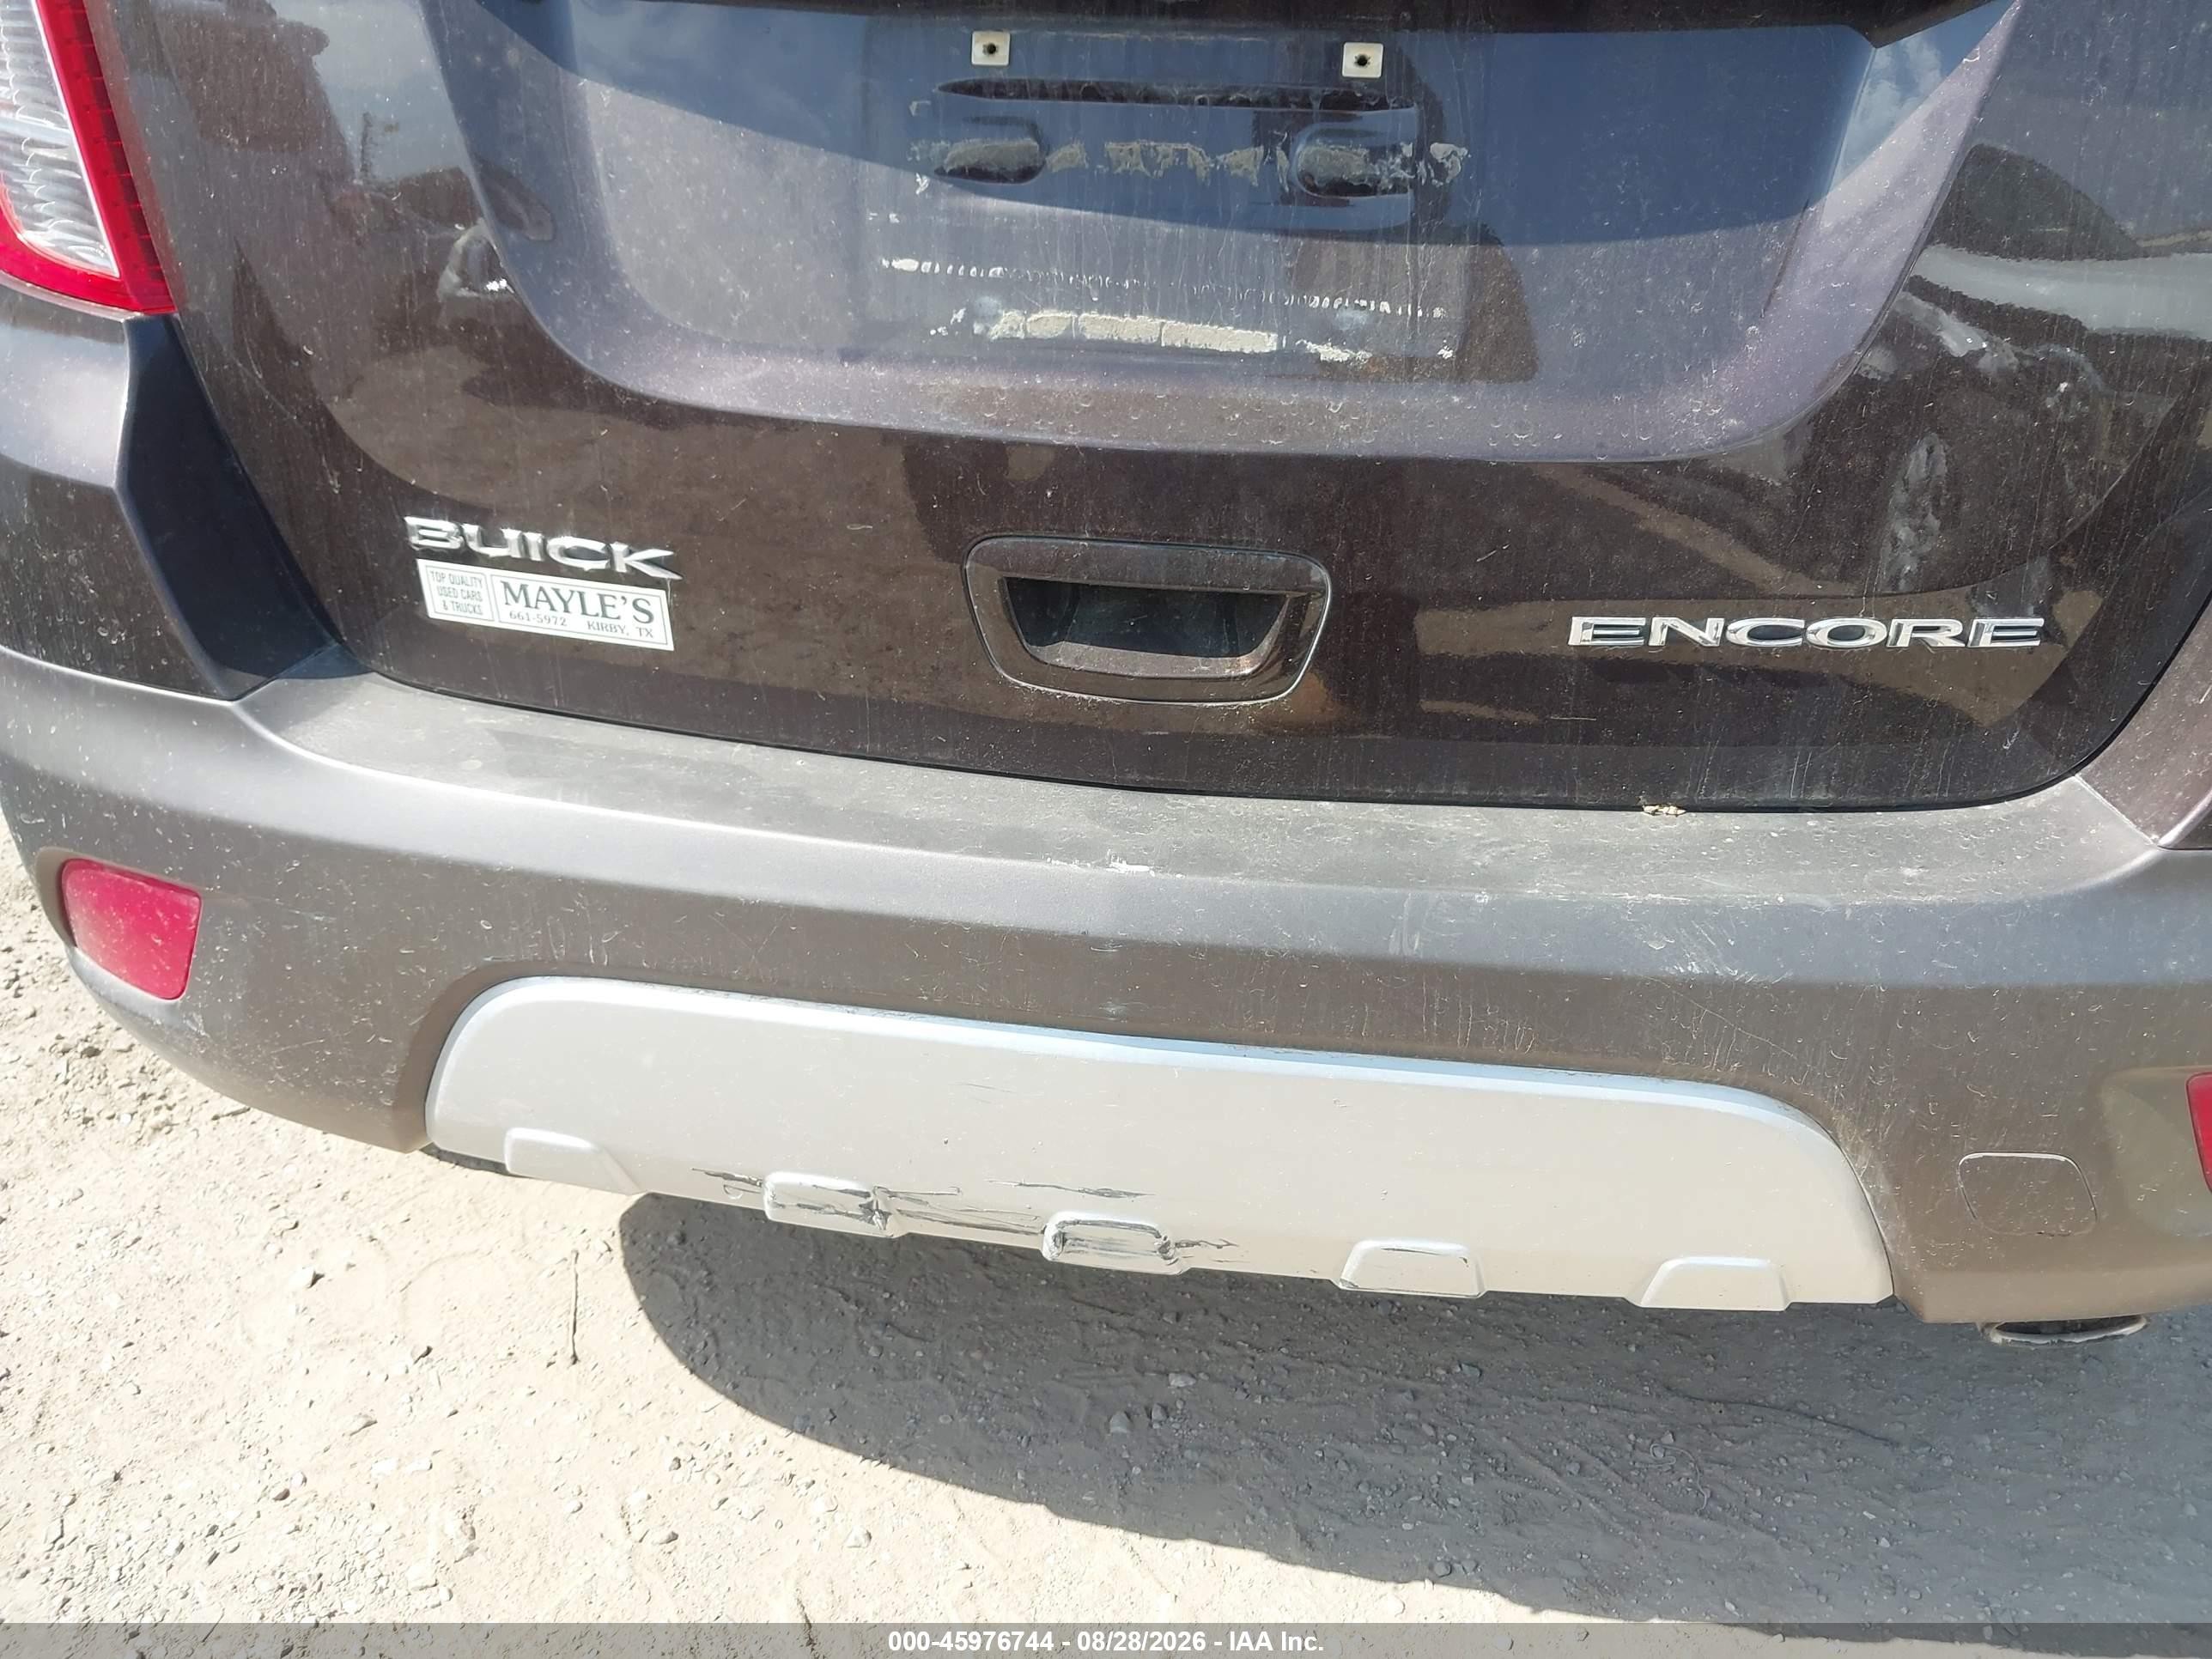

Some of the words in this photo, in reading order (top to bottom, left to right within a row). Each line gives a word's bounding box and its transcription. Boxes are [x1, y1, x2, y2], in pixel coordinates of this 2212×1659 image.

[404, 516, 684, 580] BUICK
[430, 570, 446, 582] TOP
[448, 573, 483, 589] QUALITY
[436, 586, 458, 599] USED
[460, 589, 483, 602] CARS
[451, 600, 483, 616] TRUCKS
[501, 580, 654, 624] MAYLE'S
[509, 610, 568, 628] 661-5972
[587, 620, 629, 636] KIRBY,
[635, 627, 653, 638] TX
[1568, 616, 2045, 648] ENCORE
